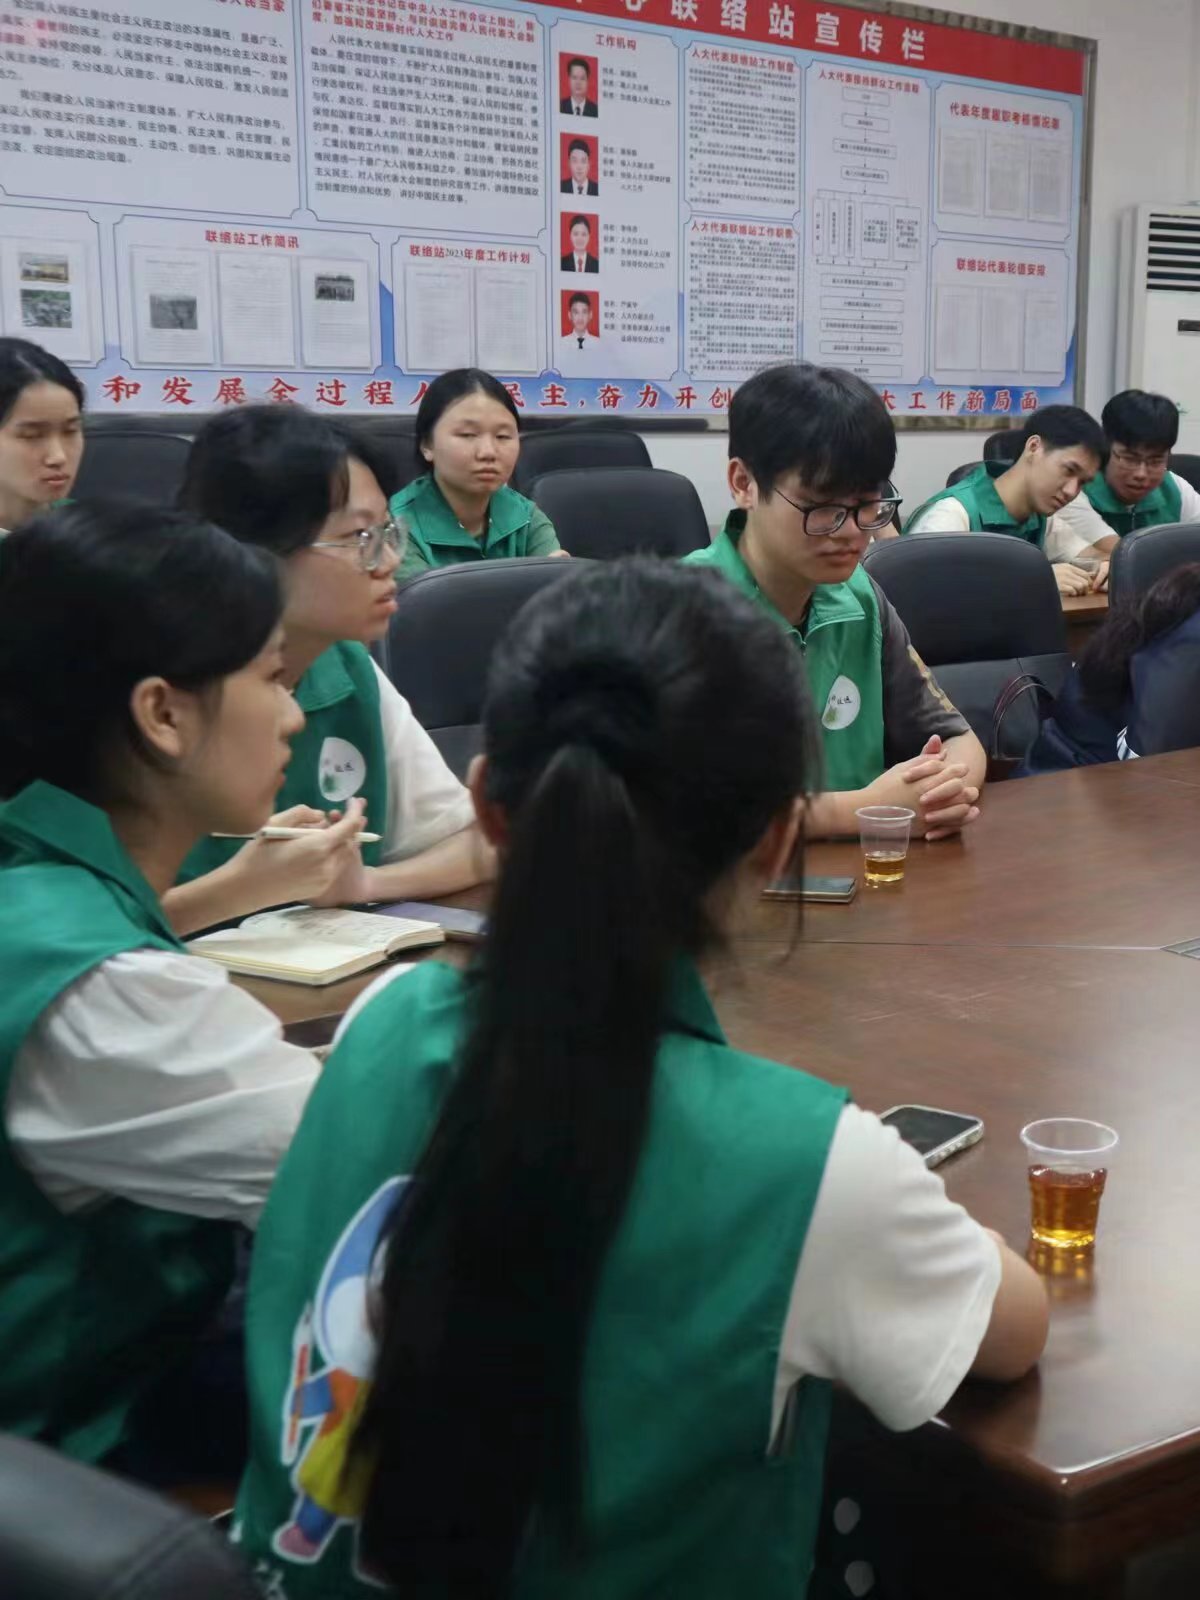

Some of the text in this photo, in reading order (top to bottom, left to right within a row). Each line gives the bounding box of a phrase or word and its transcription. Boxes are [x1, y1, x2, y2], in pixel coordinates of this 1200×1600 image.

[595, 33, 637, 50] 工作机构
[205, 229, 299, 249] 联络站工作简讯
[409, 244, 531, 264] 联络站2023年度工作计划
[956, 257, 1046, 277] 联络站代表轮值安排
